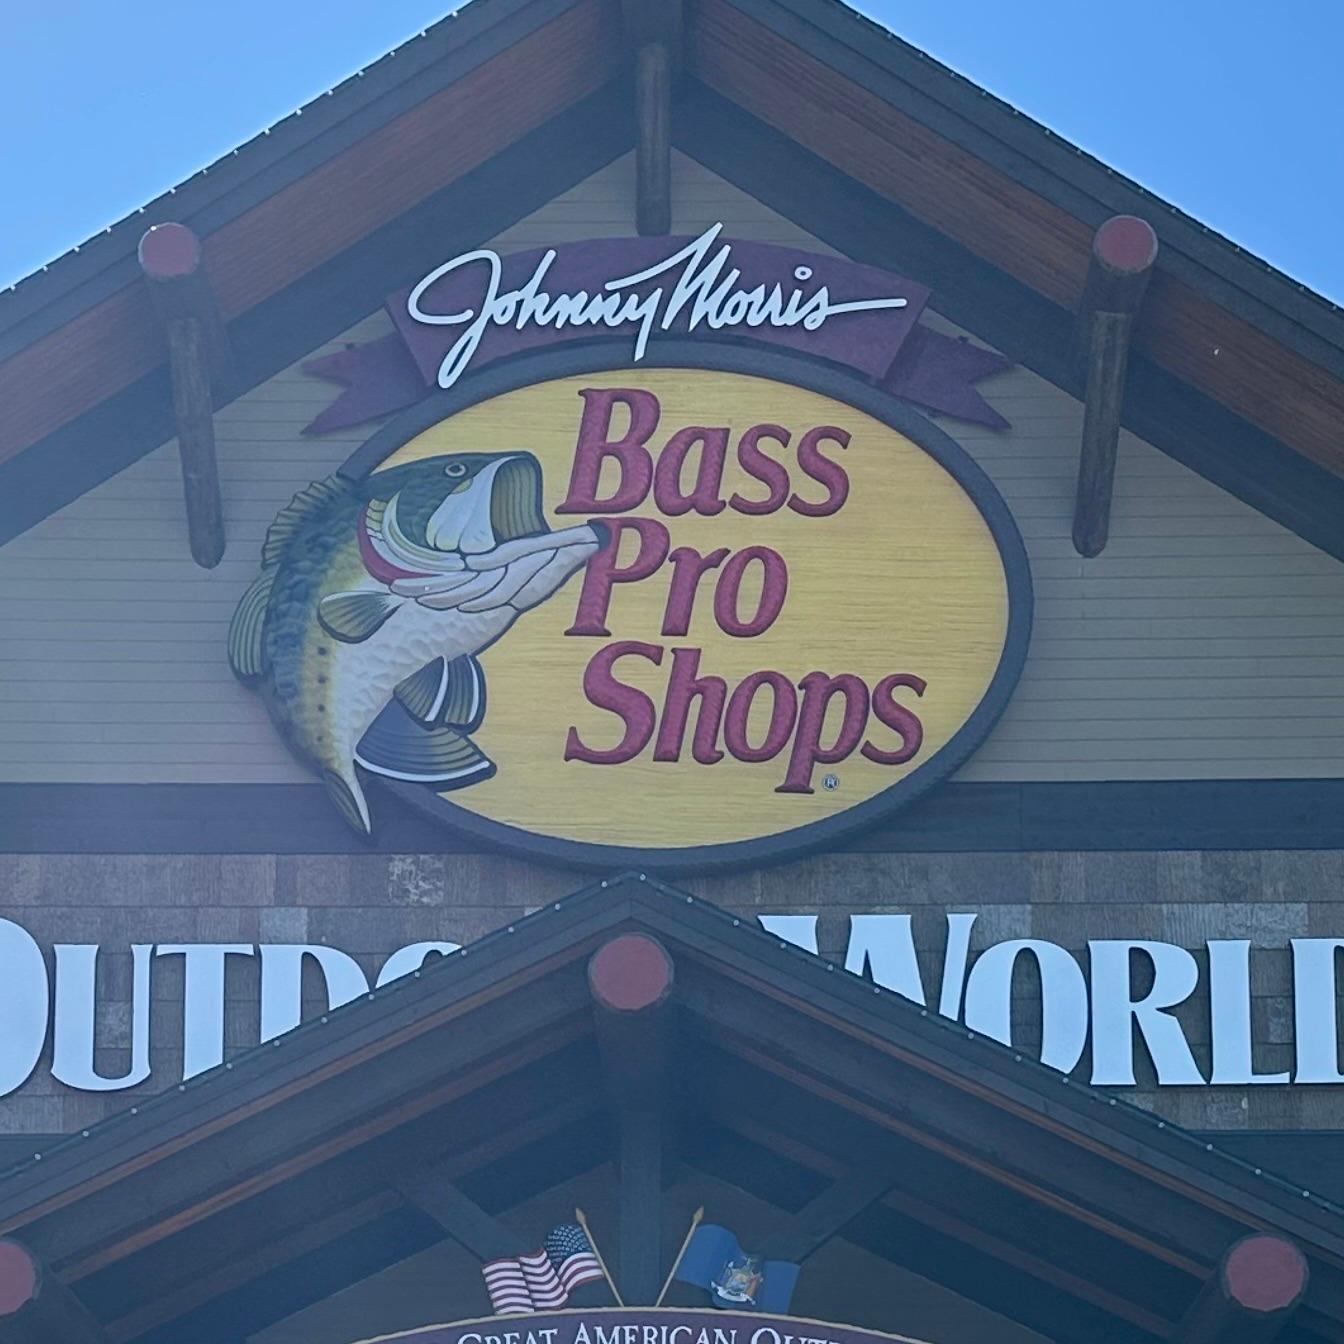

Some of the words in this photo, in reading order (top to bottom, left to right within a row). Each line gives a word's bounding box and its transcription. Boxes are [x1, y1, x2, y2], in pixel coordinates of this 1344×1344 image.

[407, 249, 664, 389] Johnny
[604, 222, 908, 332] Morris
[555, 388, 852, 516] Bass
[563, 517, 788, 637] Pro
[563, 641, 927, 793] Shops
